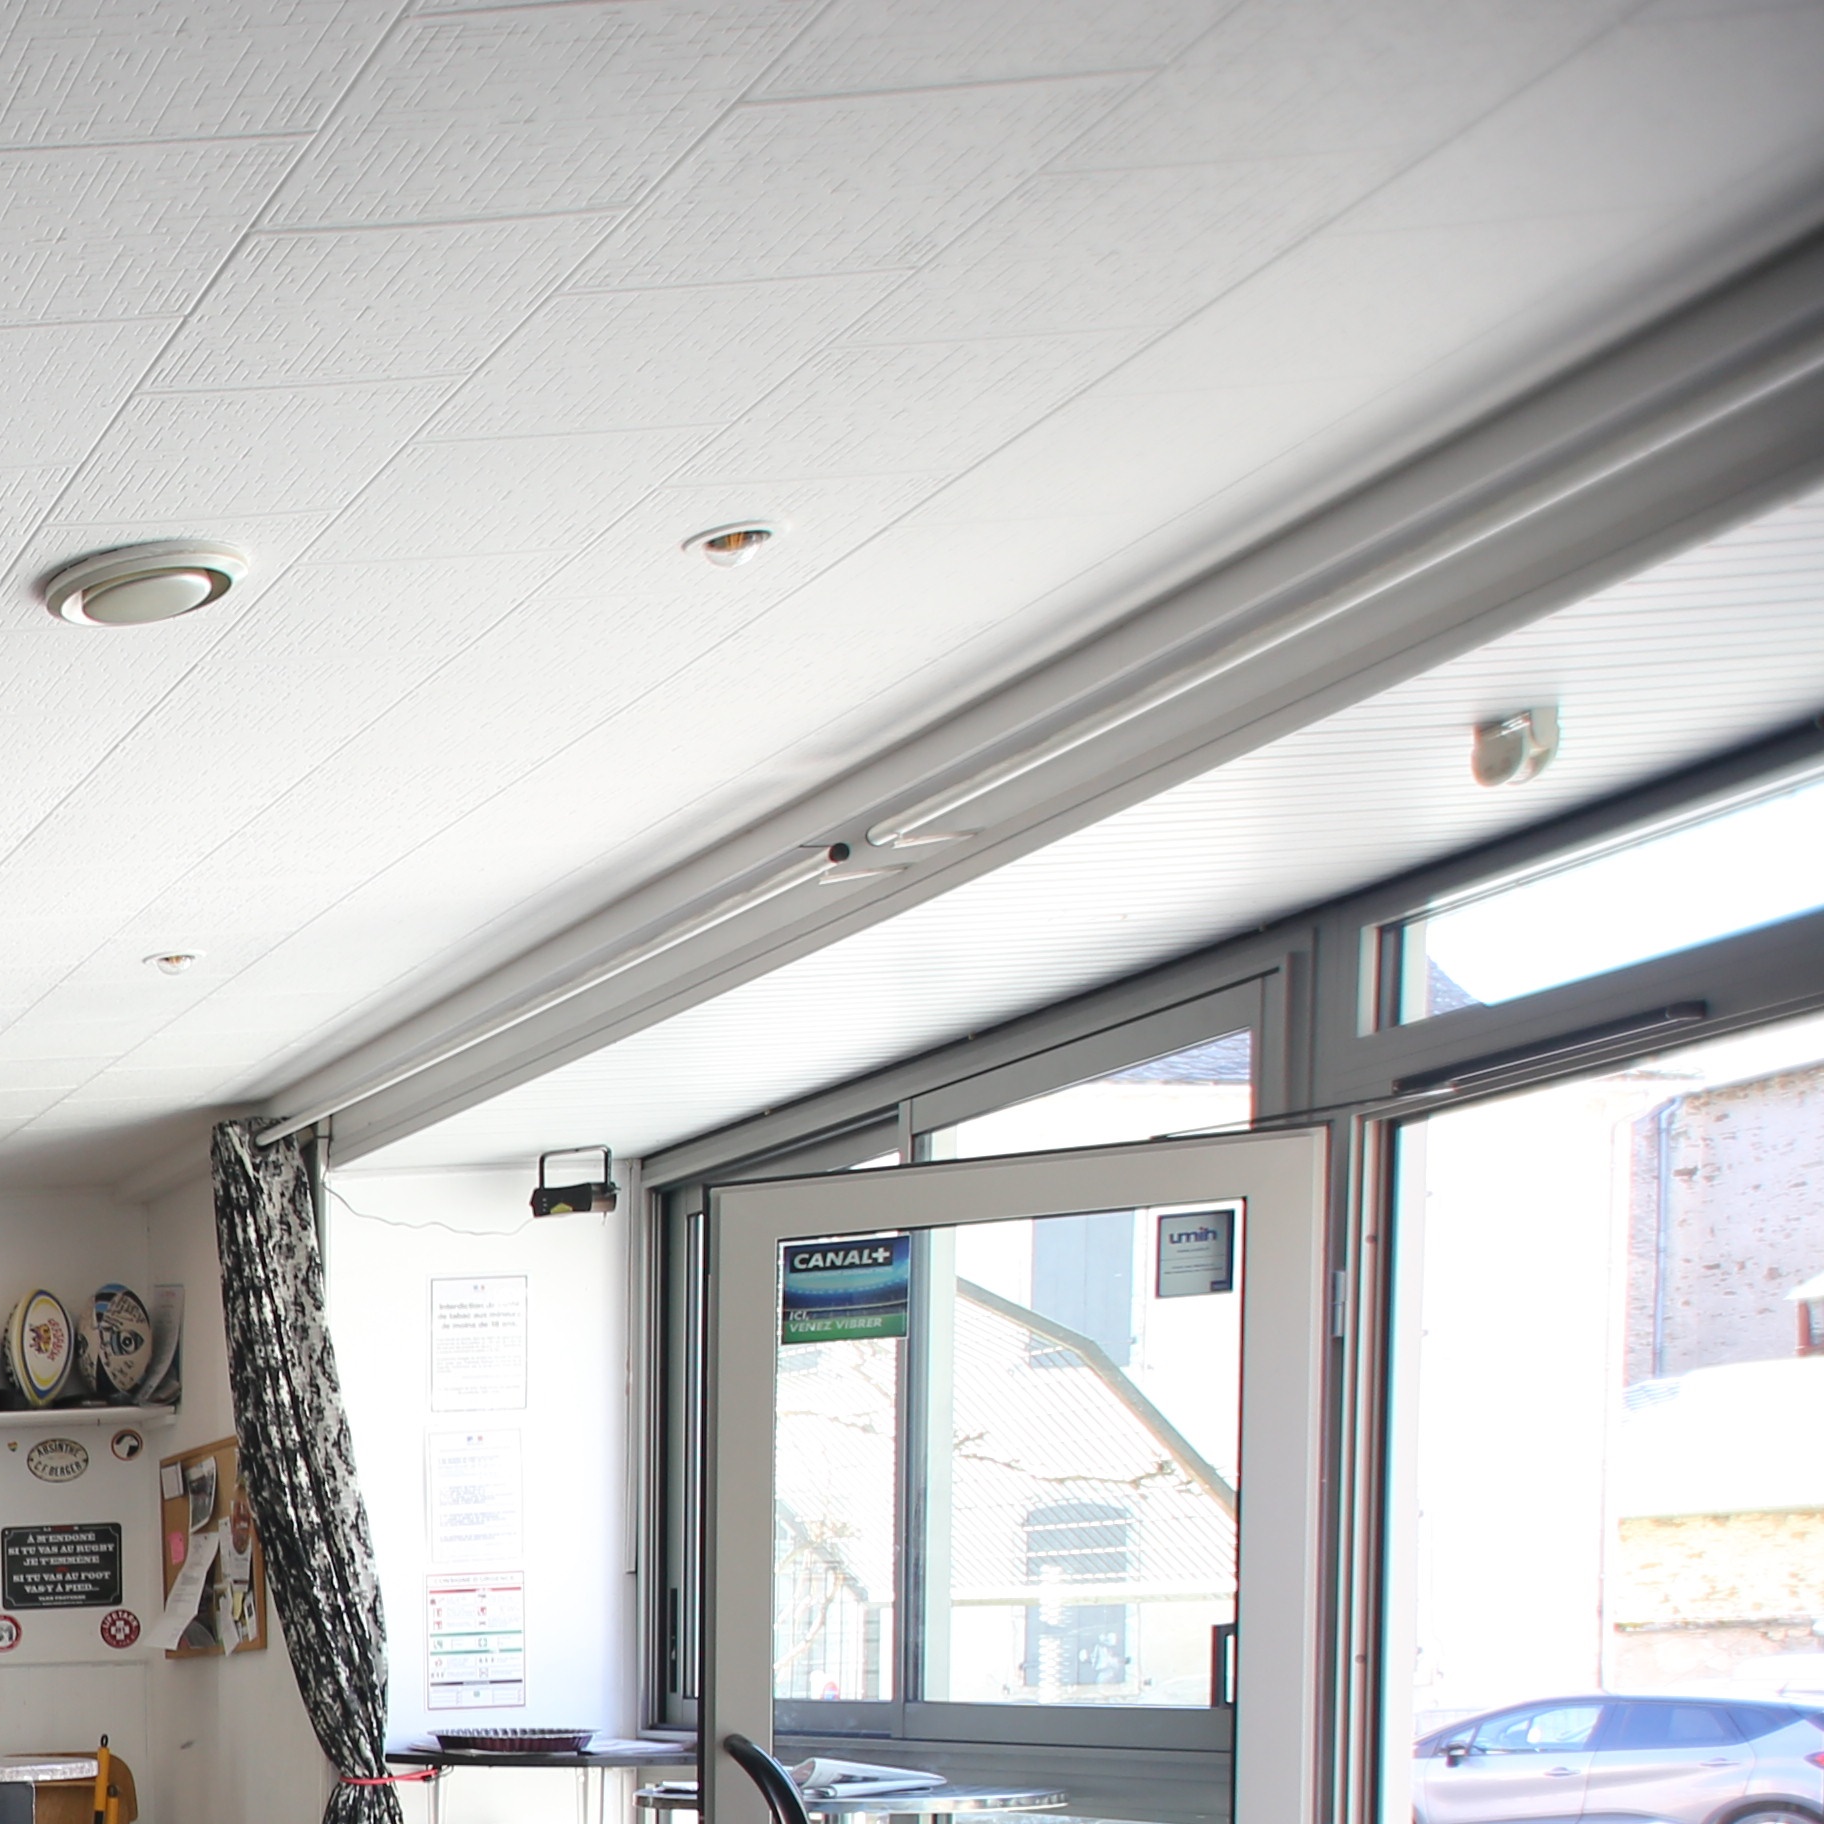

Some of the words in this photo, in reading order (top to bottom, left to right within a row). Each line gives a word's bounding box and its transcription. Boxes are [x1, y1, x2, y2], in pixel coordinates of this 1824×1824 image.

[792, 1247, 891, 1270] CANAL+
[788, 1310, 810, 1322] ICI,
[789, 1320, 832, 1333] VENEZ
[836, 1317, 883, 1331] VIBRER
[36, 1440, 81, 1458] ABSINTHE
[8, 1546, 21, 1557] SI
[21, 1546, 38, 1556] TU
[38, 1545, 60, 1556] VAS
[60, 1545, 76, 1555] AU
[76, 1543, 115, 1554] RUGBY
[23, 1557, 39, 1568] JE
[12, 1573, 25, 1584] SI
[25, 1573, 42, 1583] TU
[42, 1572, 64, 1583] VAS
[65, 1572, 80, 1582] AU
[80, 1570, 112, 1581] FOOT
